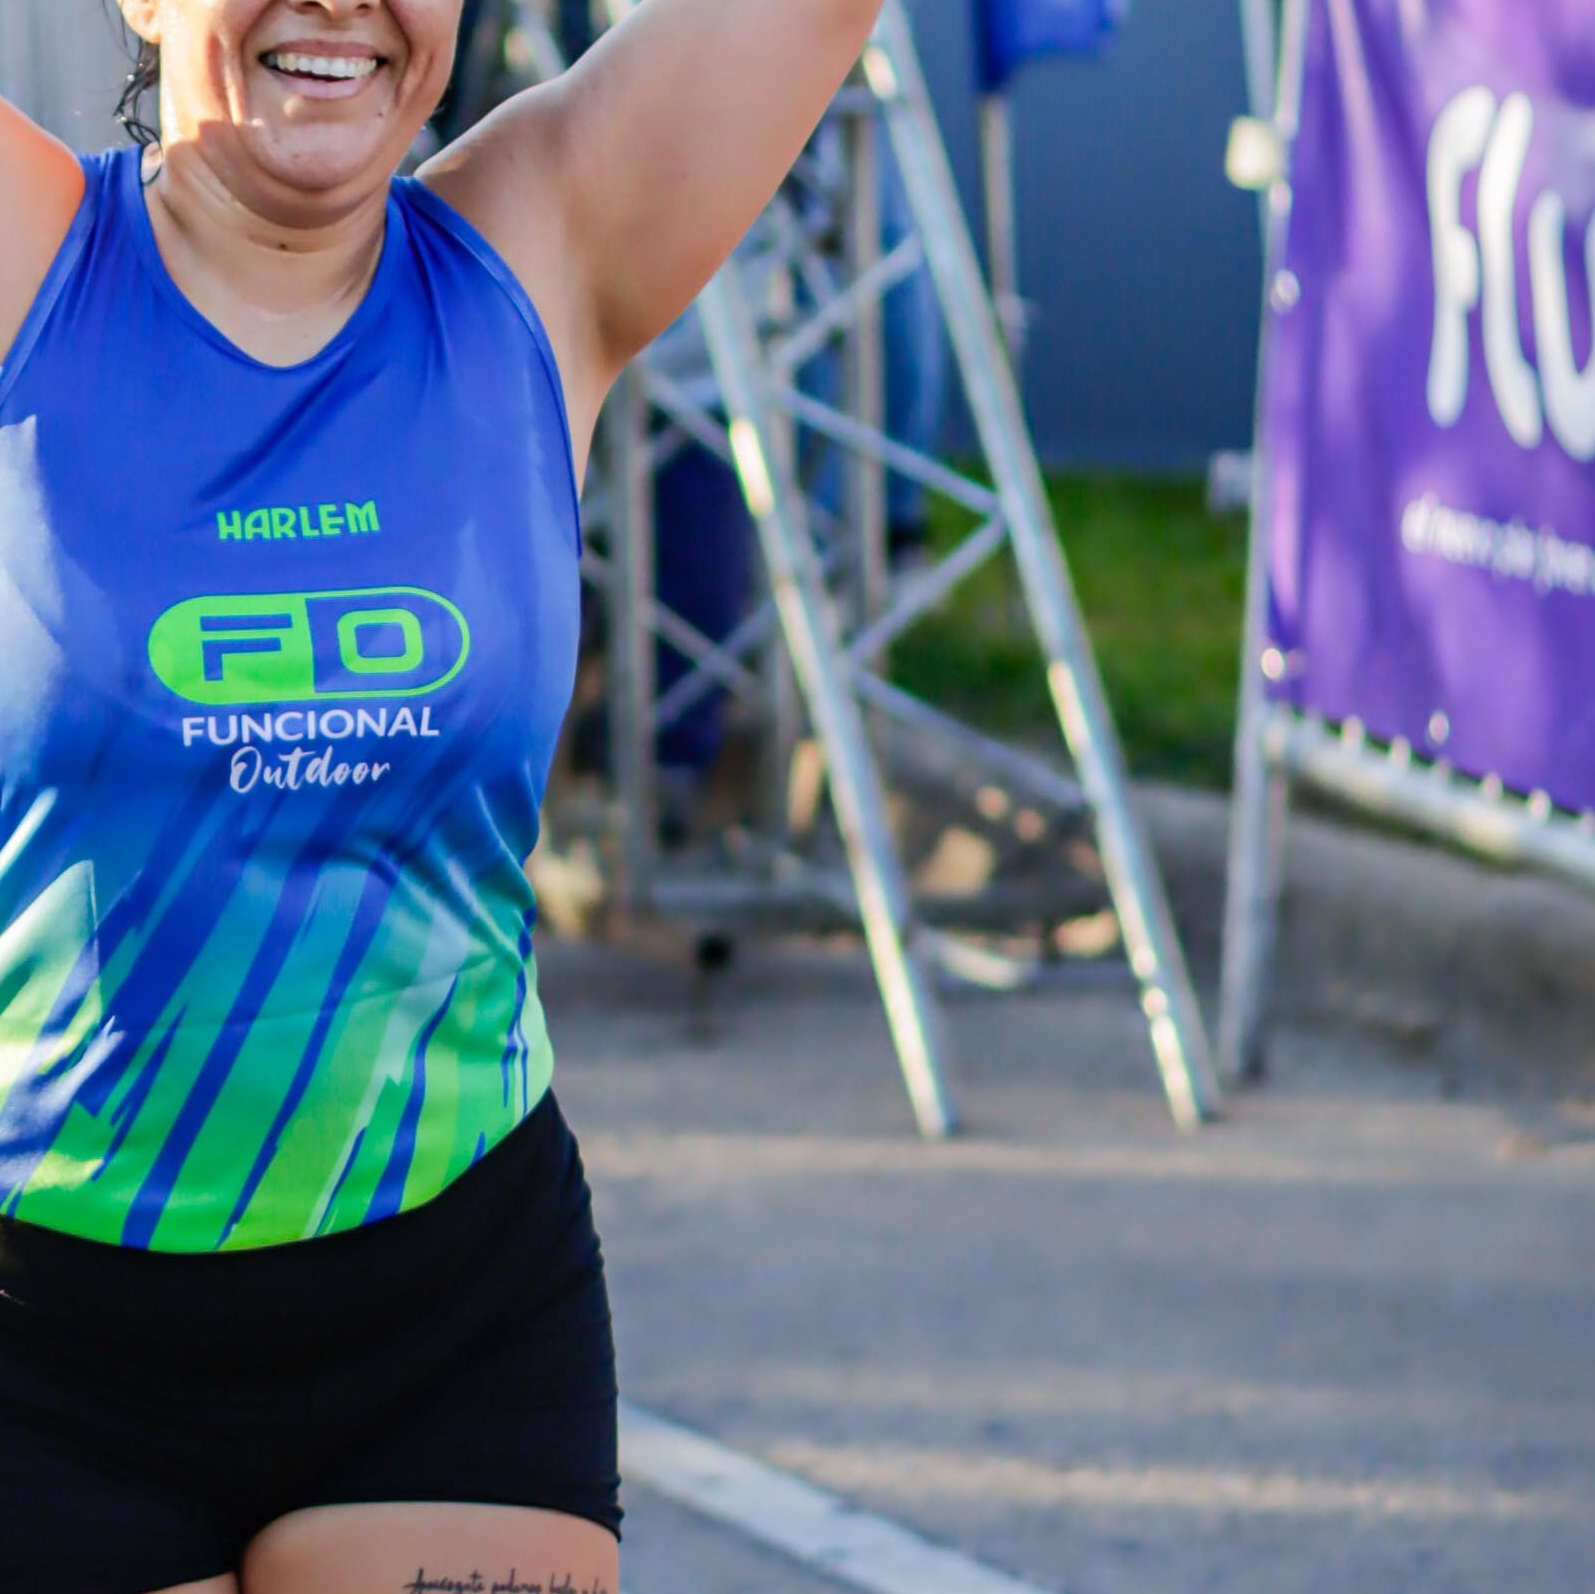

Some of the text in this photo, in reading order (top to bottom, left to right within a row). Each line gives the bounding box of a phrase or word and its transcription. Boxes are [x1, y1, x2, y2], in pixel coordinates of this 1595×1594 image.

[216, 500, 380, 541] HARLEM
[200, 608, 424, 682] FO
[182, 706, 440, 747] FUNCIONAL
[229, 745, 391, 793] Outdoor
